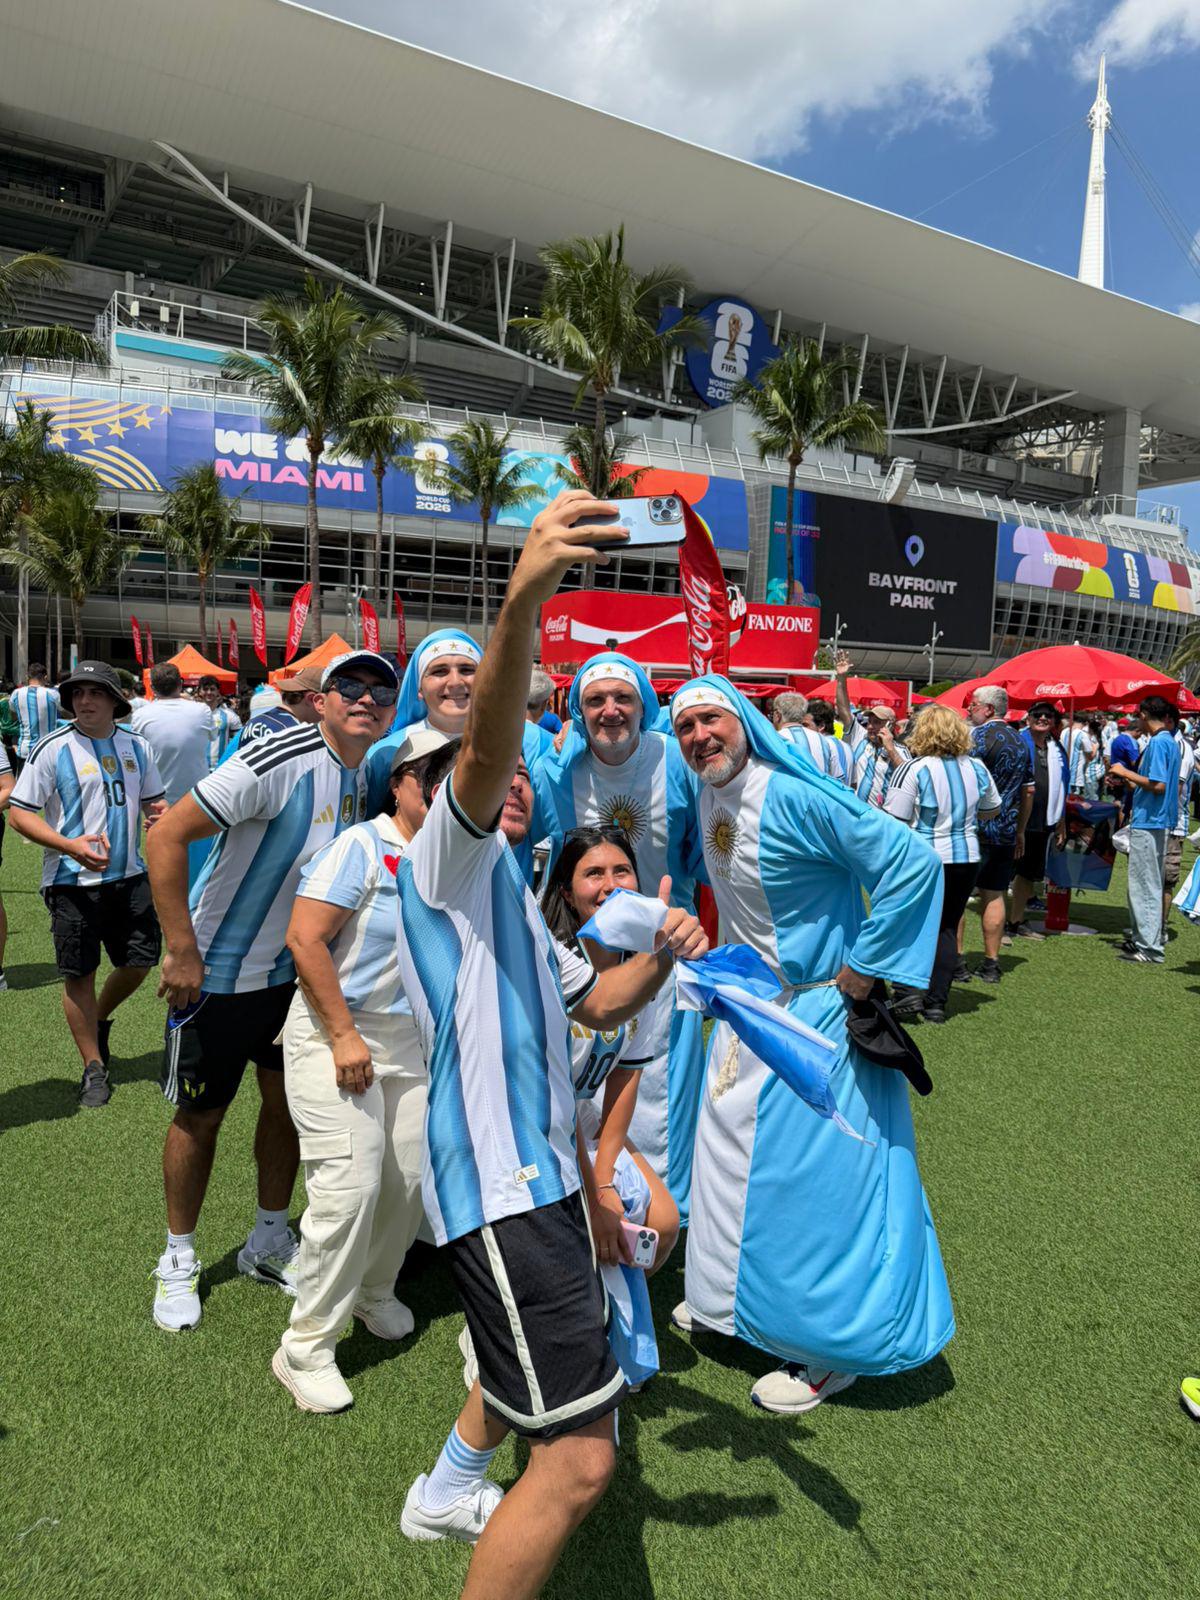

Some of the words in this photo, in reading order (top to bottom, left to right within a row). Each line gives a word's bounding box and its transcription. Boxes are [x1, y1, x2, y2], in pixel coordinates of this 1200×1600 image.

[721, 363, 737, 374] FIFA
[706, 387, 735, 402] 202
[215, 428, 278, 459] WE
[214, 458, 366, 492] MIAMI
[416, 495, 437, 503] WORLD
[416, 501, 451, 513] 2026
[868, 572, 958, 594] BAYFRONT
[889, 592, 935, 610] PARK
[545, 614, 569, 634] Coca-Cola
[748, 614, 775, 630] FAN
[776, 616, 813, 632] ZONE
[1035, 683, 1072, 696] Coca-Cola
[575, 1052, 616, 1091] 10
